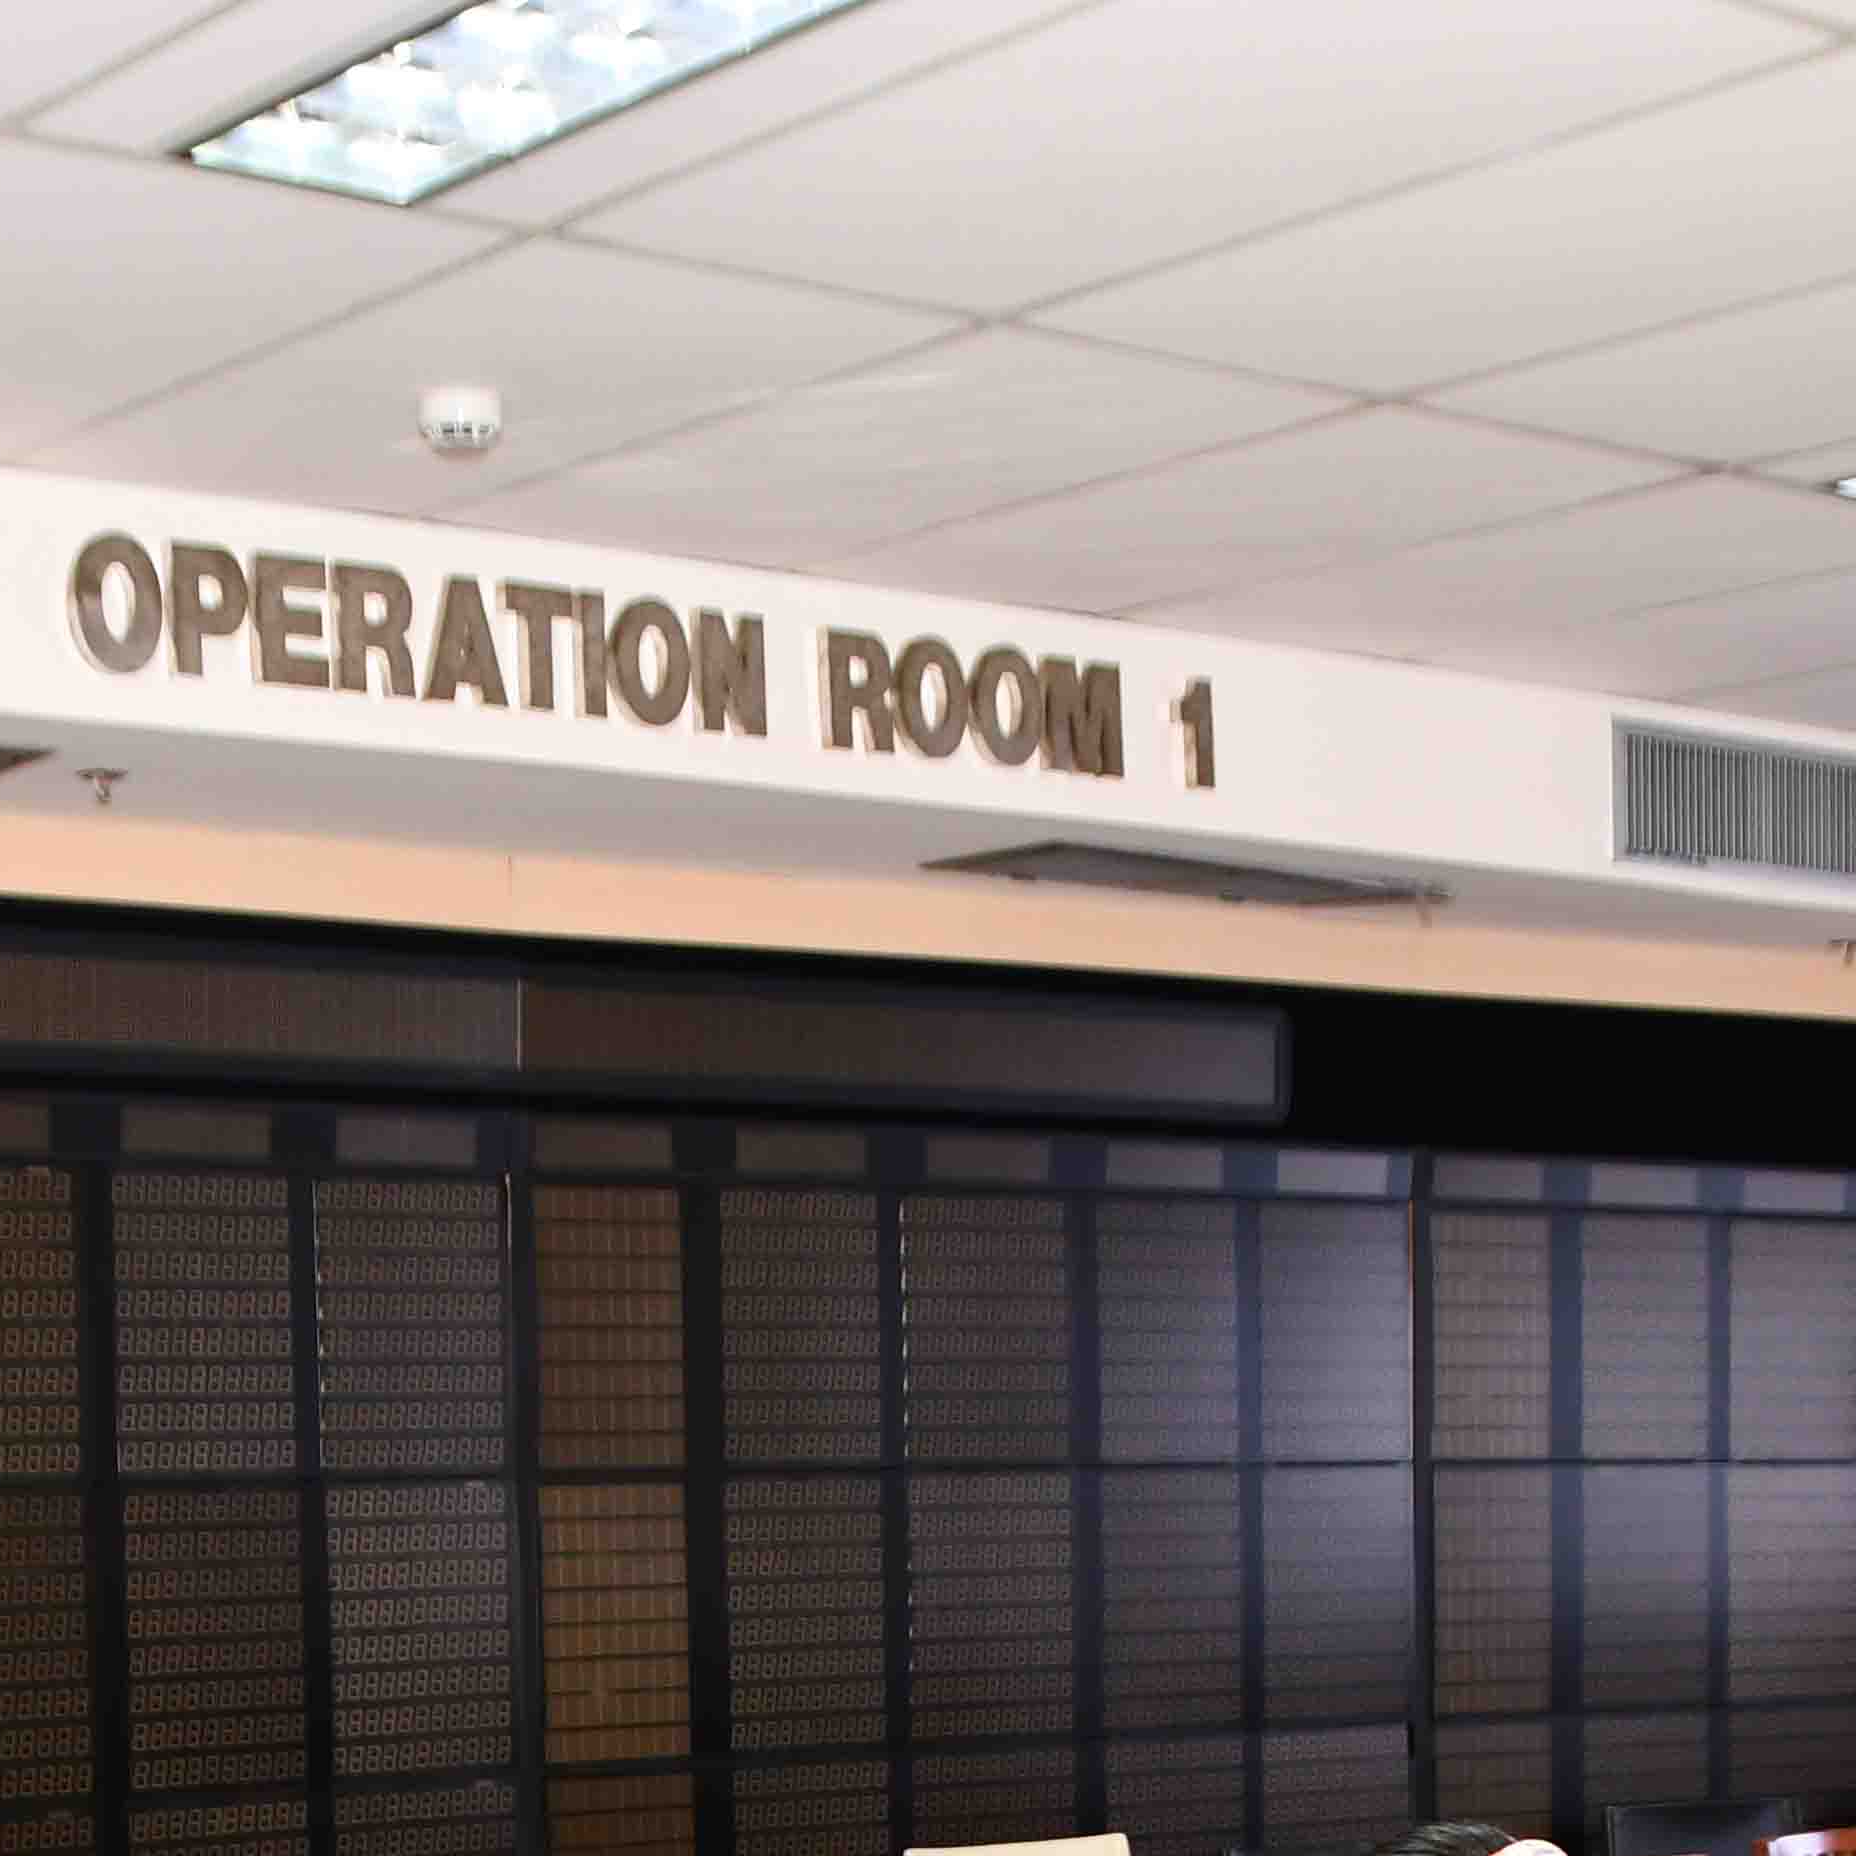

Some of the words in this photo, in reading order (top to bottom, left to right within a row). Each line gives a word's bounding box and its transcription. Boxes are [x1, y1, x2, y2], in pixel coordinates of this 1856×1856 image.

[68, 529, 768, 738] OPERATION
[819, 623, 1125, 780] ROOM
[1170, 678, 1216, 791] 1
